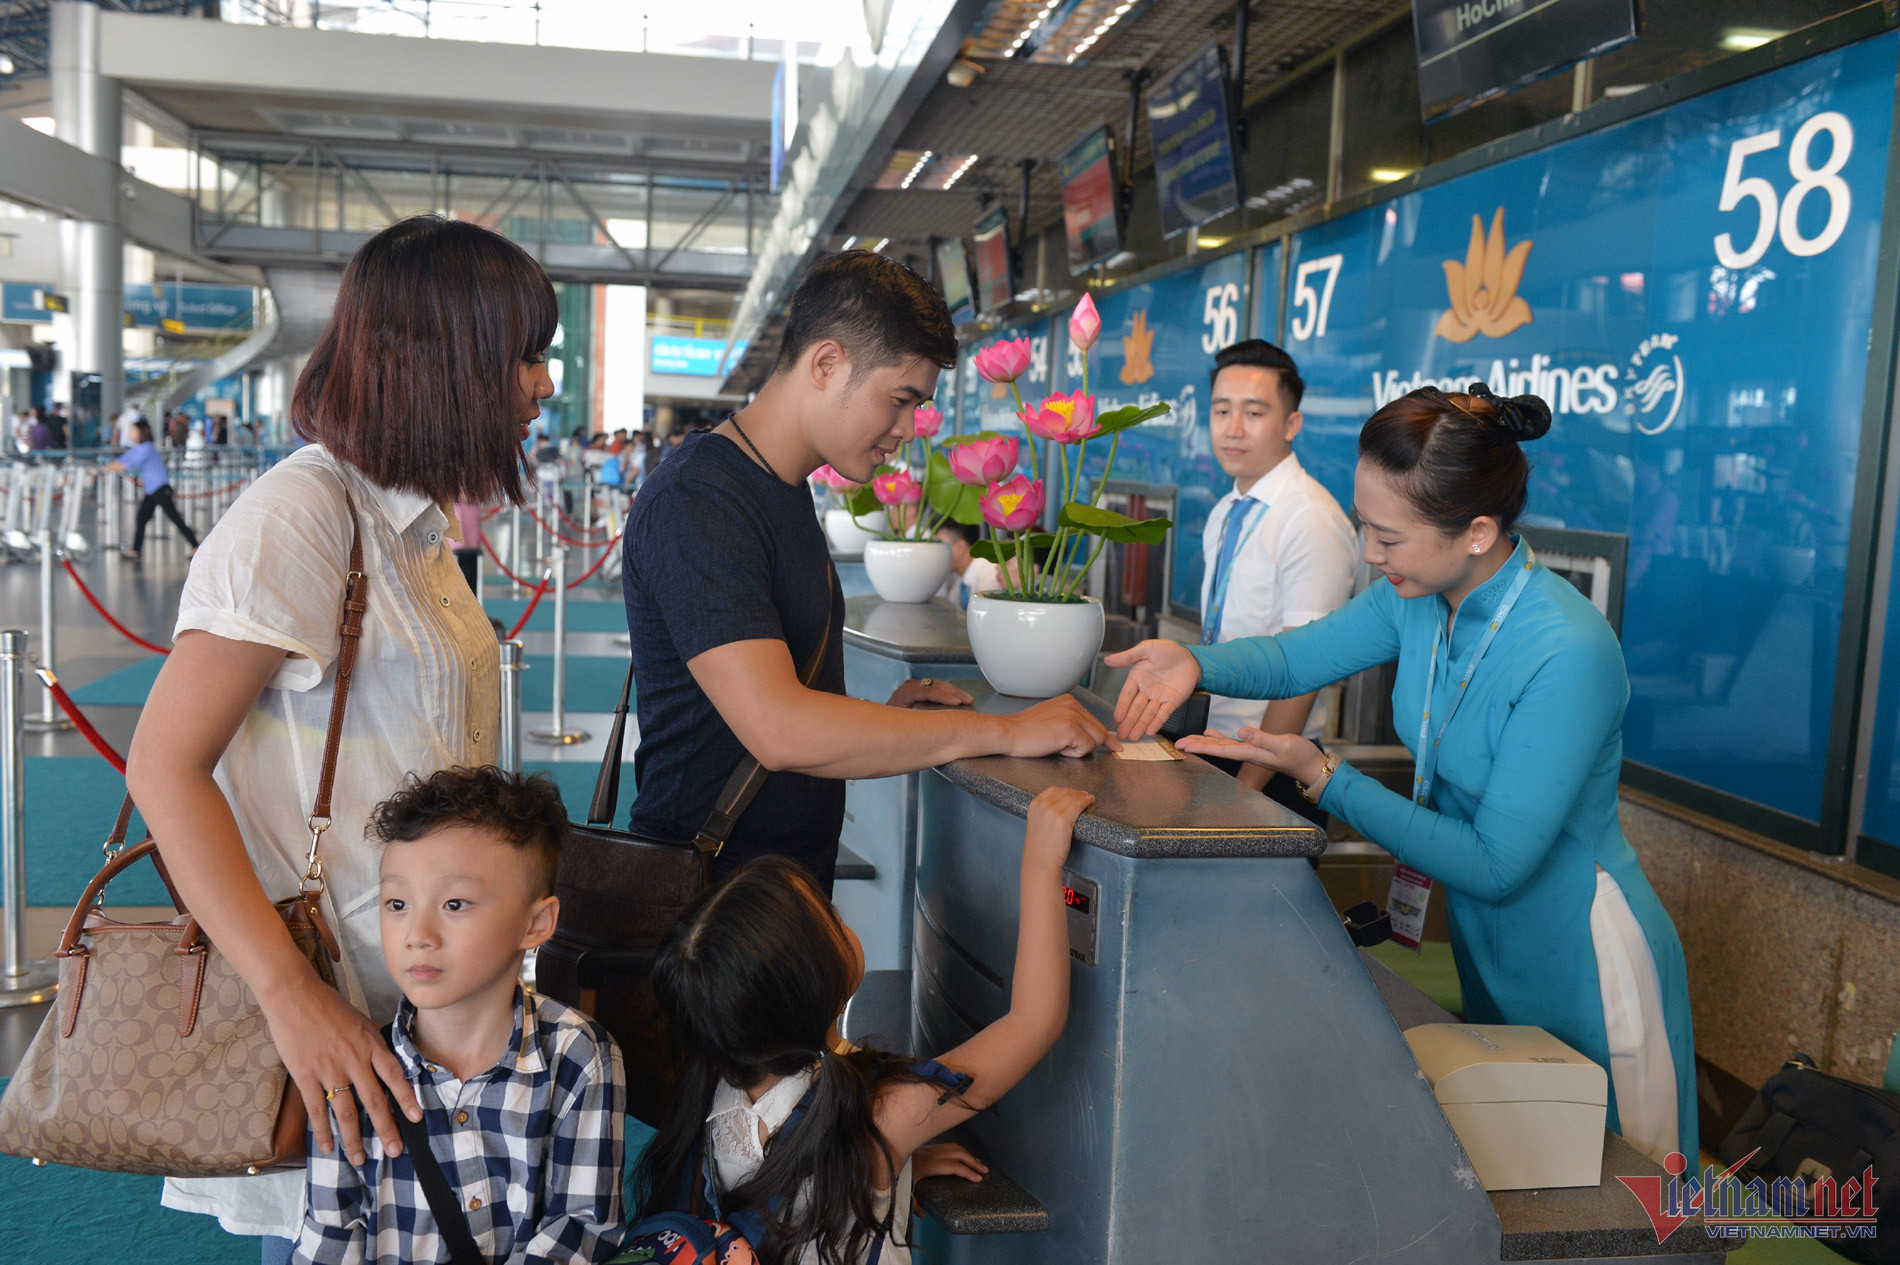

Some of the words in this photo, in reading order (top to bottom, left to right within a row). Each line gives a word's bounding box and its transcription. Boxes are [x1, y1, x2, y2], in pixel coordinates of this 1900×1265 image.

[1714, 111, 1854, 270] 58
[1202, 282, 1238, 354] 56
[1291, 252, 1344, 341] 57
[1067, 341, 1085, 378] 5
